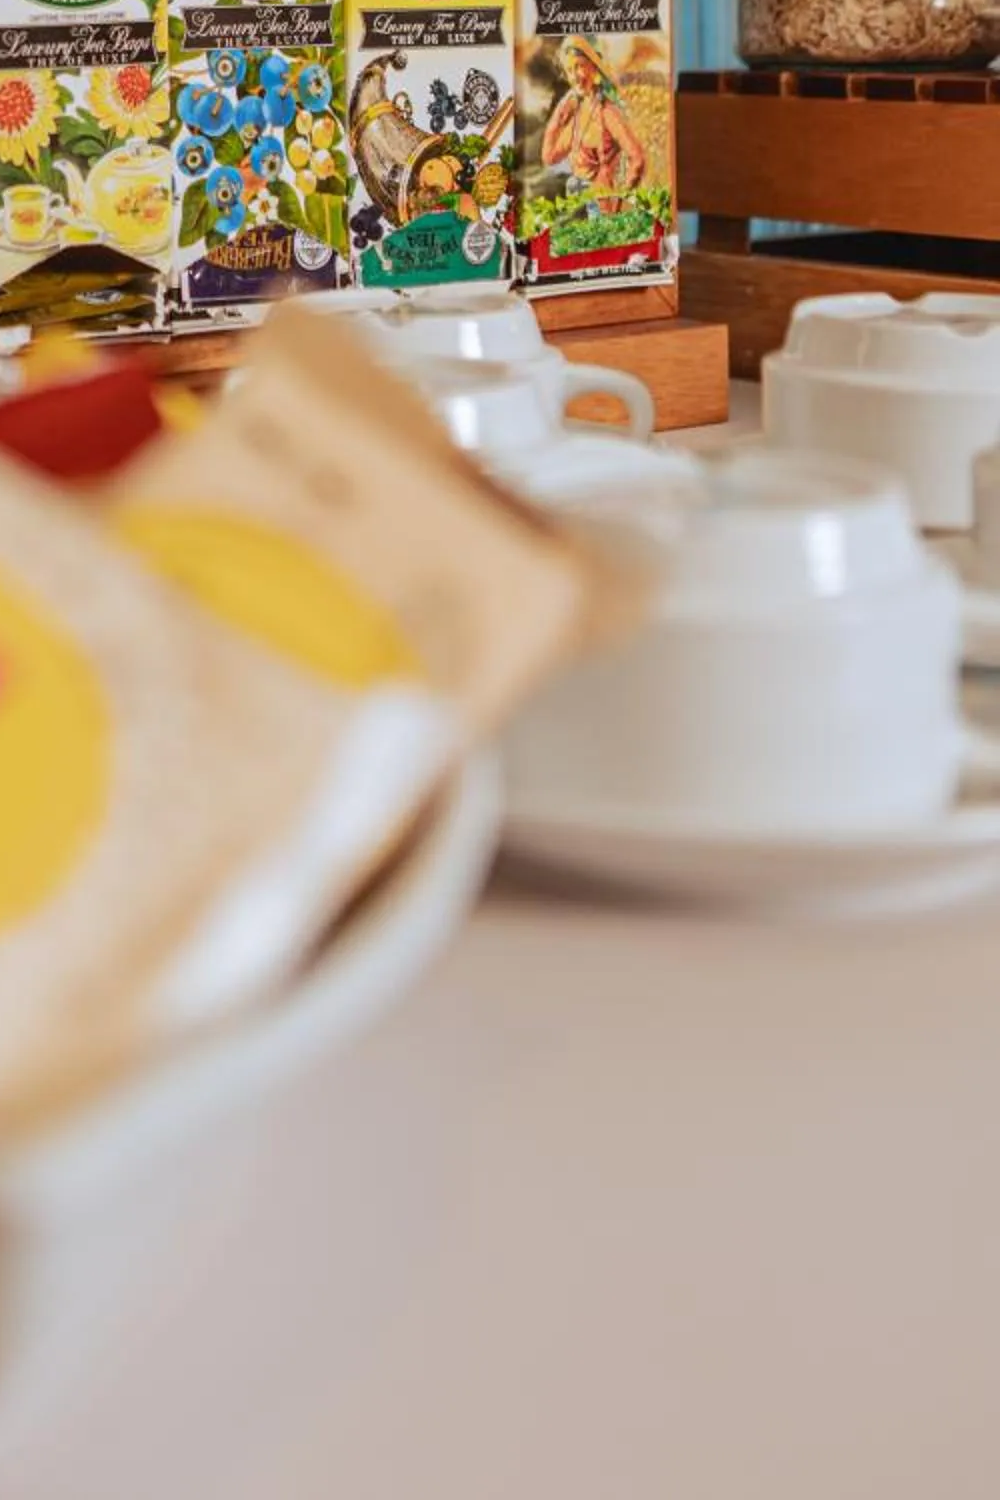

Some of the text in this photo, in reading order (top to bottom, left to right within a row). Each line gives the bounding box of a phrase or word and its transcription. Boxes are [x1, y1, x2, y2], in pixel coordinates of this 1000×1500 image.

[187, 7, 330, 42] Luxury Tea Bags
[372, 11, 497, 38] Luxury Tea Bags
[537, 0, 597, 25] Luxury
[70, 25, 106, 53] Tea
[107, 26, 152, 58] Bags
[423, 32, 476, 45] DE LUXE
